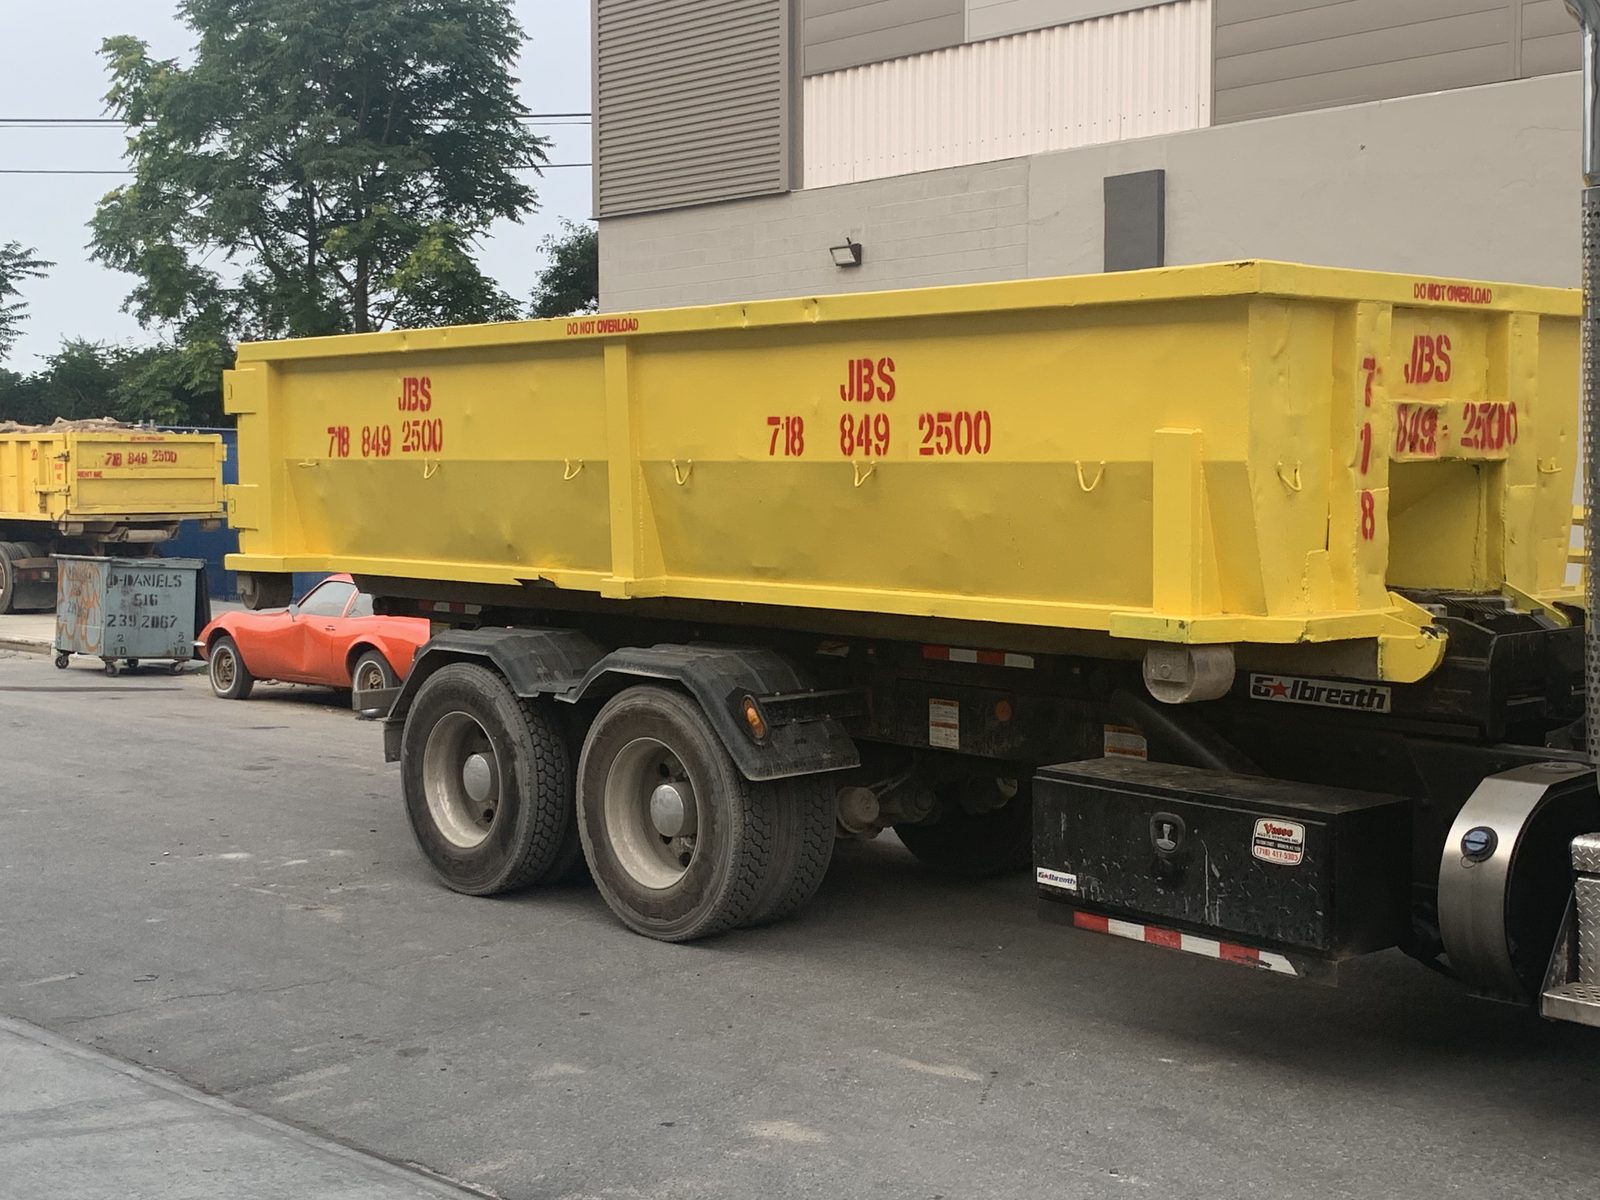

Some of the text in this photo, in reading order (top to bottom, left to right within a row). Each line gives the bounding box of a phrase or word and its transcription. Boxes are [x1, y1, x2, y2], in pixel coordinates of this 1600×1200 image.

[1414, 282, 1492, 304] DO NOT OVERLOAD
[567, 318, 638, 336] DO NOT OVERLOAD
[1404, 334, 1452, 384] JBS
[398, 376, 432, 412] JBS
[840, 356, 896, 402] JBS
[327, 418, 444, 458] 718 849 2500
[767, 410, 992, 457] 718 849 2500
[1396, 401, 1519, 455] 849 2500
[104, 449, 178, 467] 718 849 2500
[106, 614, 137, 628] 239
